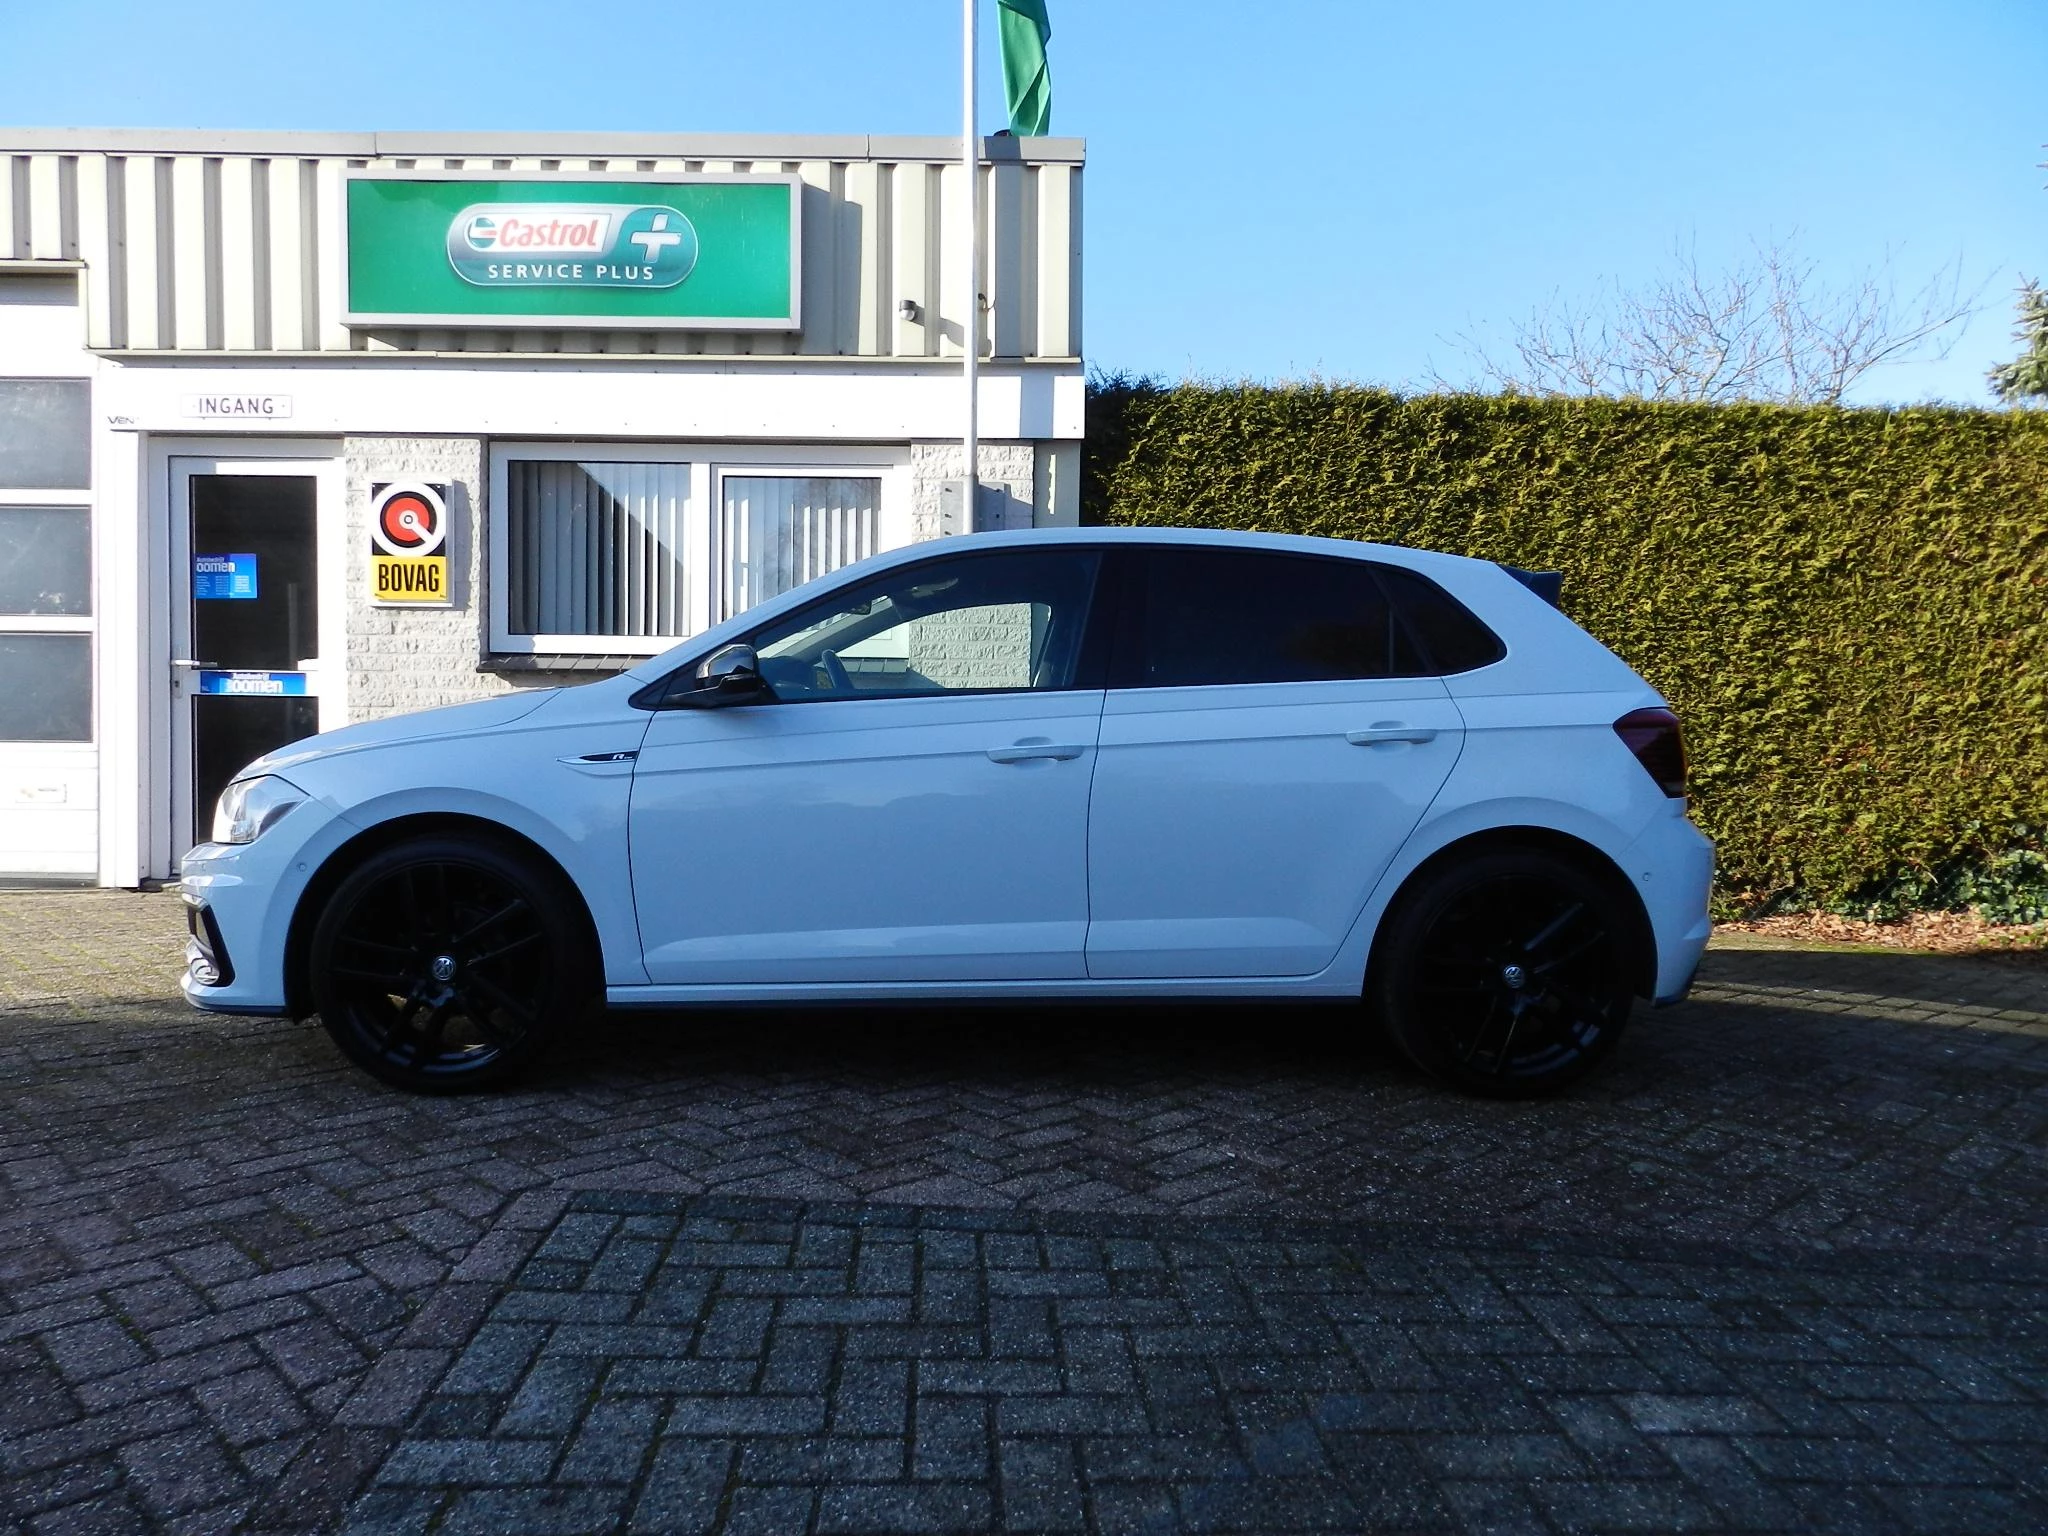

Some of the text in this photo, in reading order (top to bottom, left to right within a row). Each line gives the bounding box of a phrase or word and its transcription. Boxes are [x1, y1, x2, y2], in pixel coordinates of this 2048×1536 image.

[501, 219, 599, 248] Castrol
[488, 264, 655, 280] SERVICE PLUS
[199, 398, 275, 414] INGANG
[378, 563, 440, 592] BOVAG
